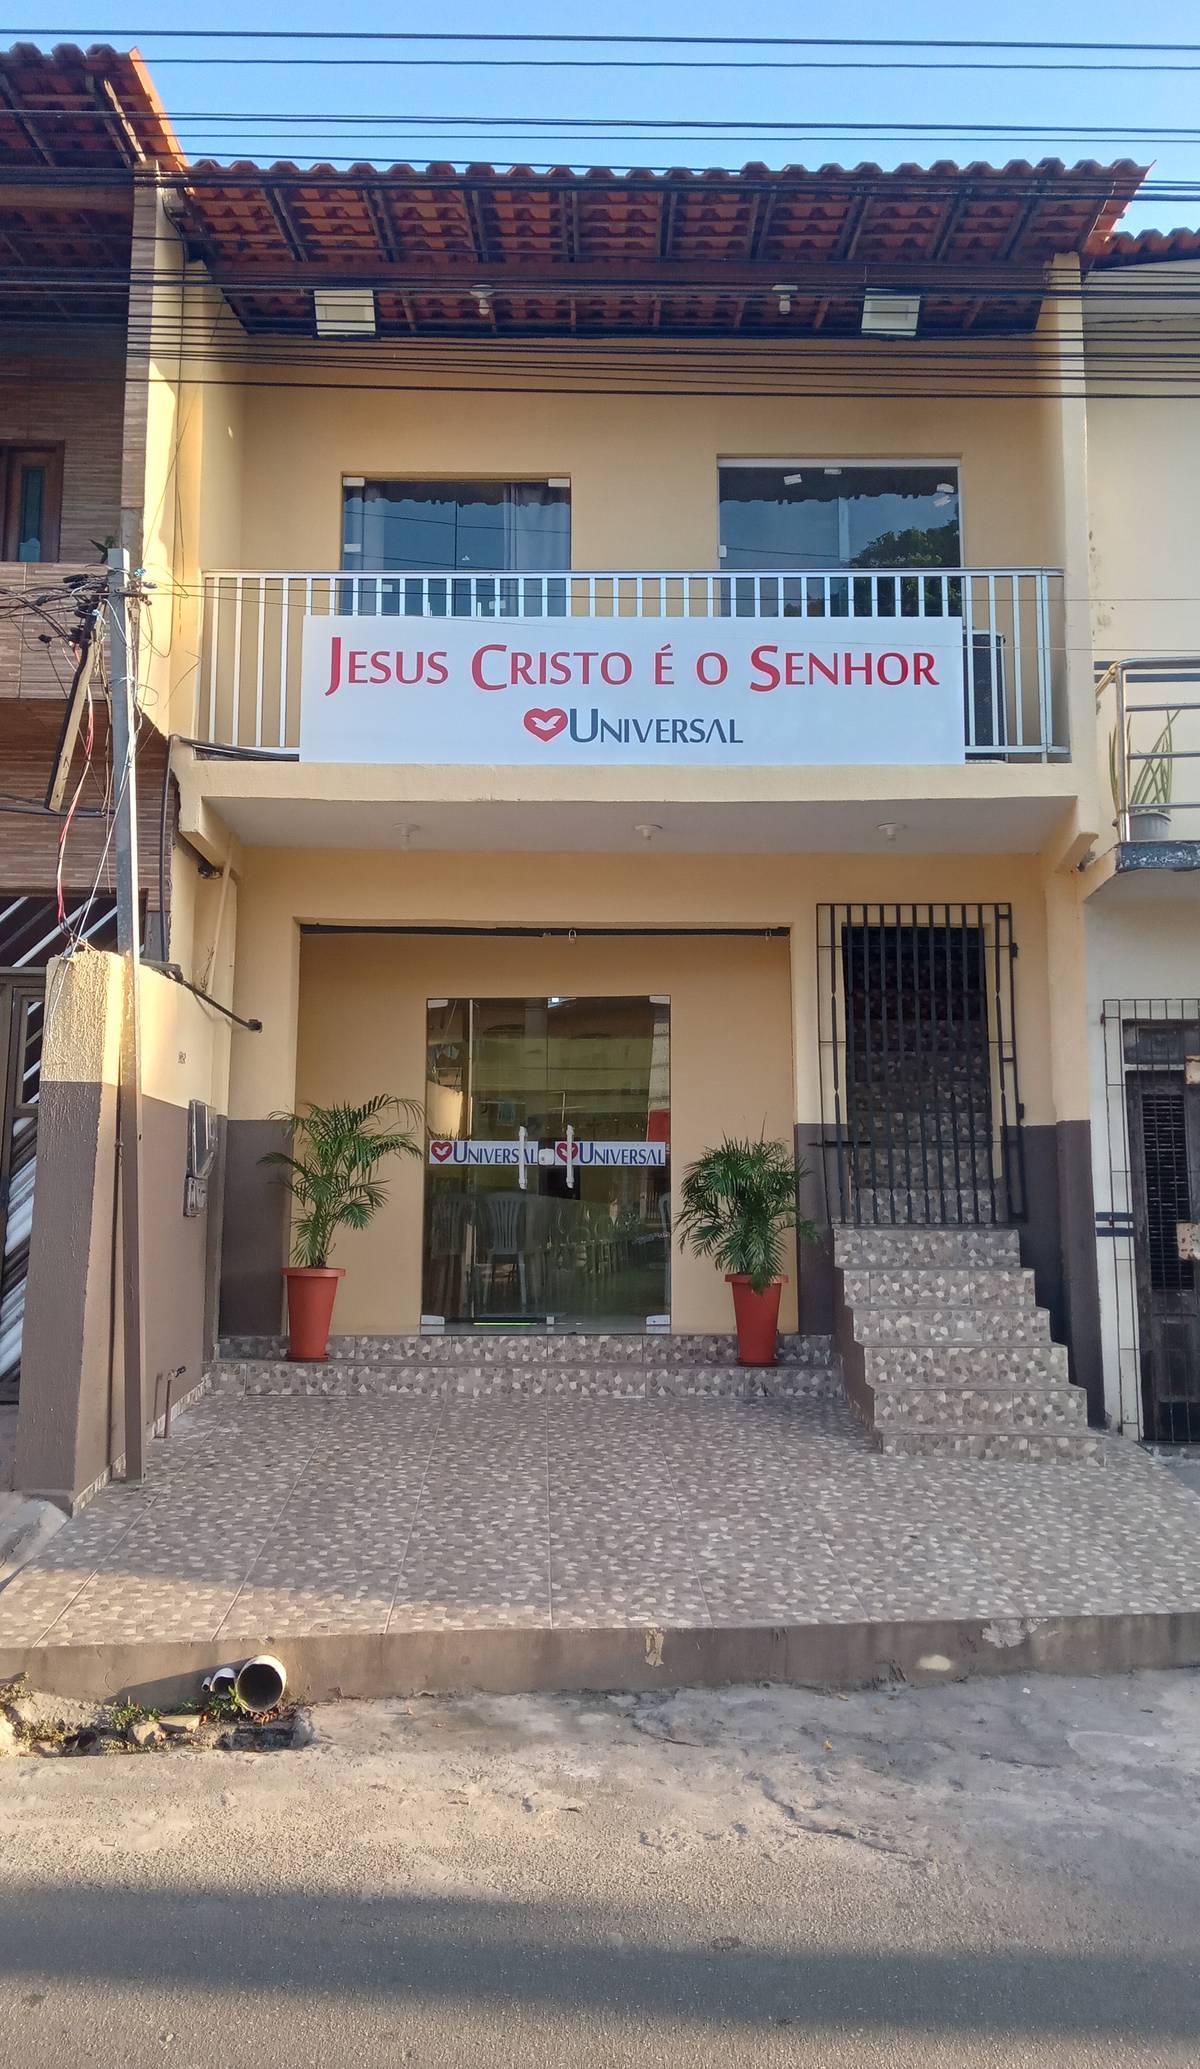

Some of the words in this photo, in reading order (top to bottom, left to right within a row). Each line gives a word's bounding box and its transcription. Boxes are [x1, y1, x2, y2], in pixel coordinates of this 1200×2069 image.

[325, 636, 449, 696] JESUS
[471, 644, 633, 690] CRISTO
[655, 643, 676, 685] É
[696, 651, 729, 686] O
[749, 645, 940, 692] SENHOR
[569, 708, 744, 744] UNIVERSAL
[579, 1142, 665, 1165] UNIVERSAL
